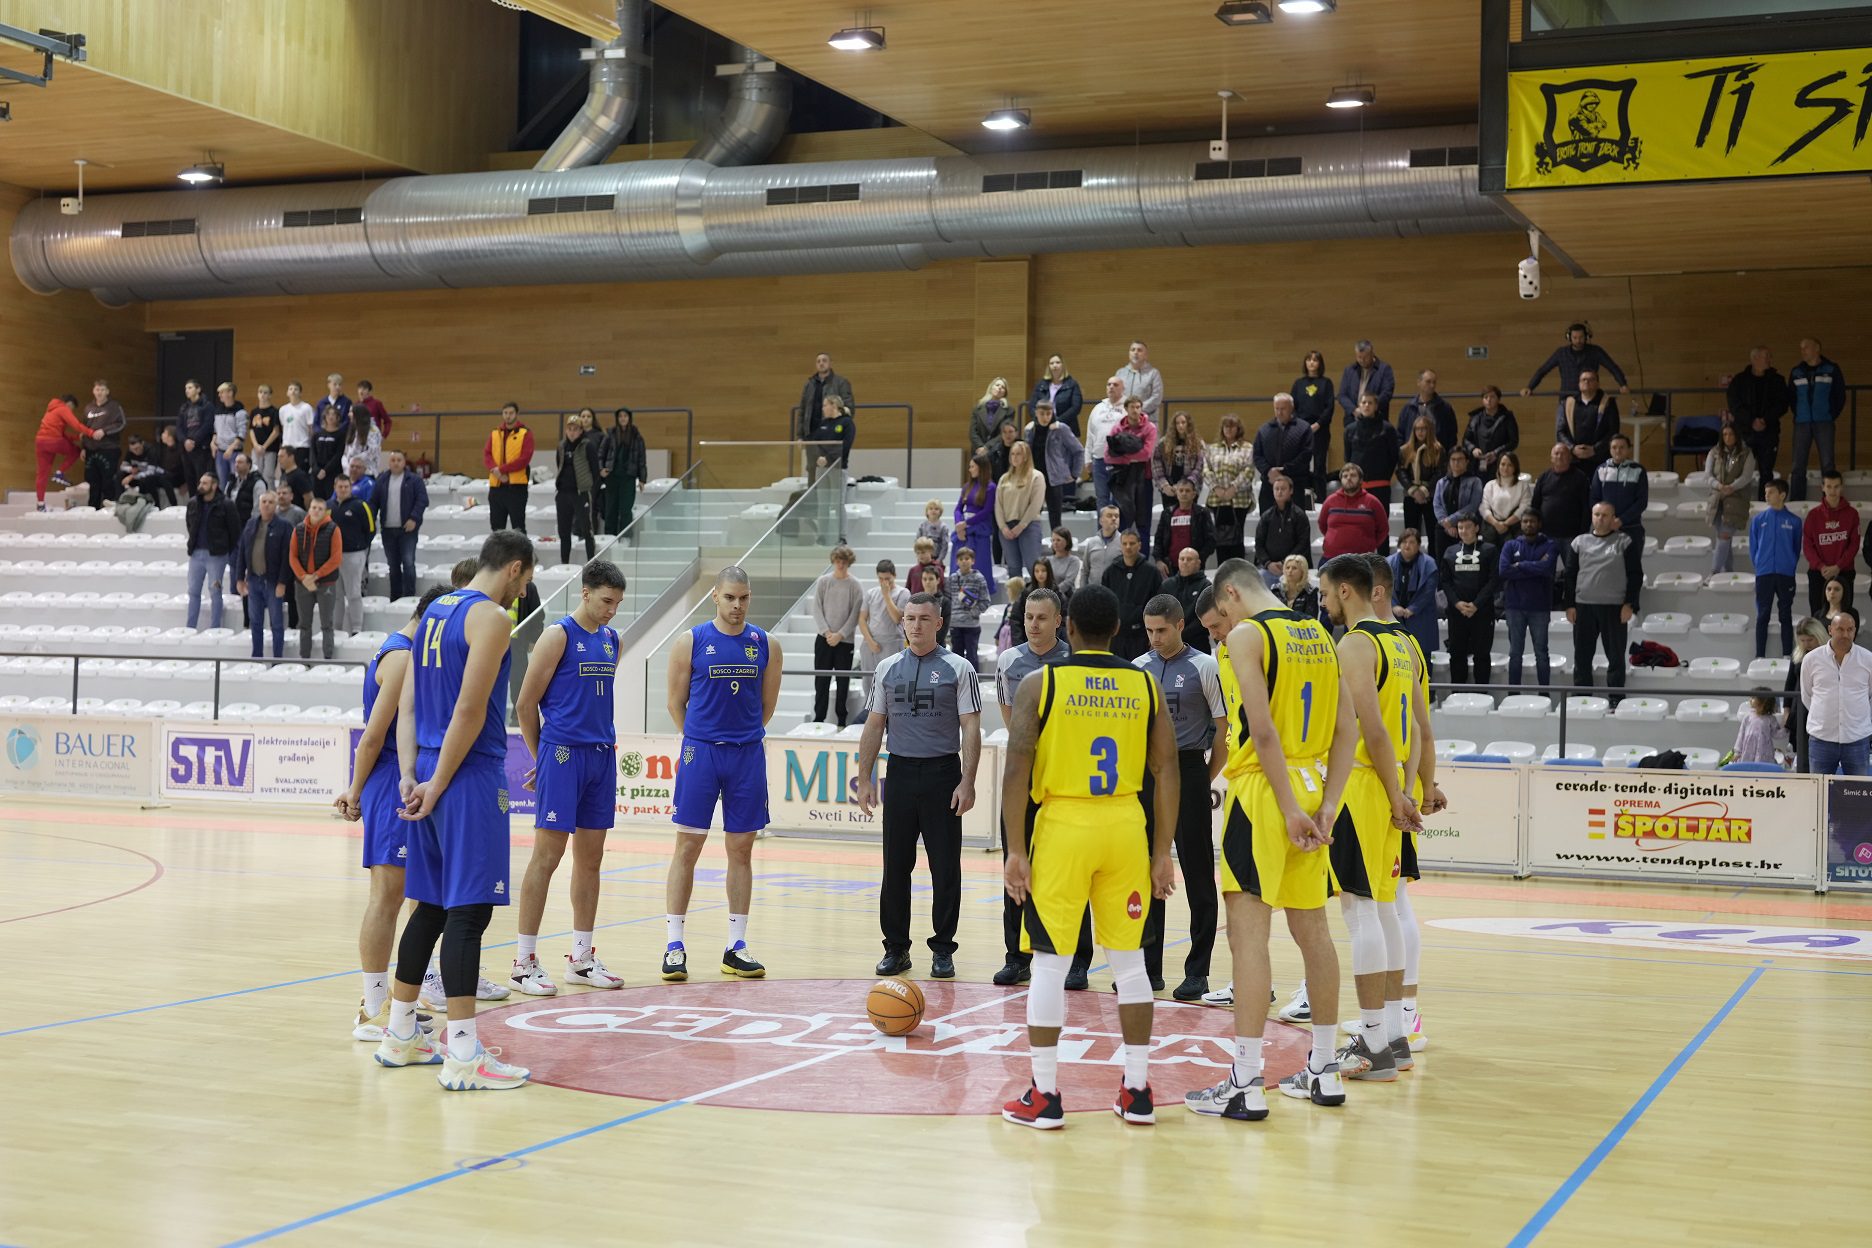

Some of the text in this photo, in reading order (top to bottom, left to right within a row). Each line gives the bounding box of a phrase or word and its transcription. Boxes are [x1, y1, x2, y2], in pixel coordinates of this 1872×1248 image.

[1683, 62, 1767, 158] Ti
[422, 617, 448, 668] 14
[596, 680, 604, 696] 11
[730, 680, 740, 695] 9
[1085, 676, 1119, 690] NEAL
[1066, 694, 1141, 711] ADRIATIC
[1064, 708, 1140, 721] OSIGURANJE
[1301, 681, 1312, 743] 1
[55, 732, 137, 758] BAUER
[257, 735, 331, 749] elektroinstalacije
[1089, 736, 1119, 796] 3
[630, 785, 670, 800] pizza
[1663, 783, 1735, 799] digitalni
[1742, 785, 1787, 799] tisak
[633, 805, 661, 815] park
[1614, 799, 1661, 809] OPREMA
[809, 809, 842, 822] Sveti
[1616, 808, 1750, 843] ŠPOLJAR
